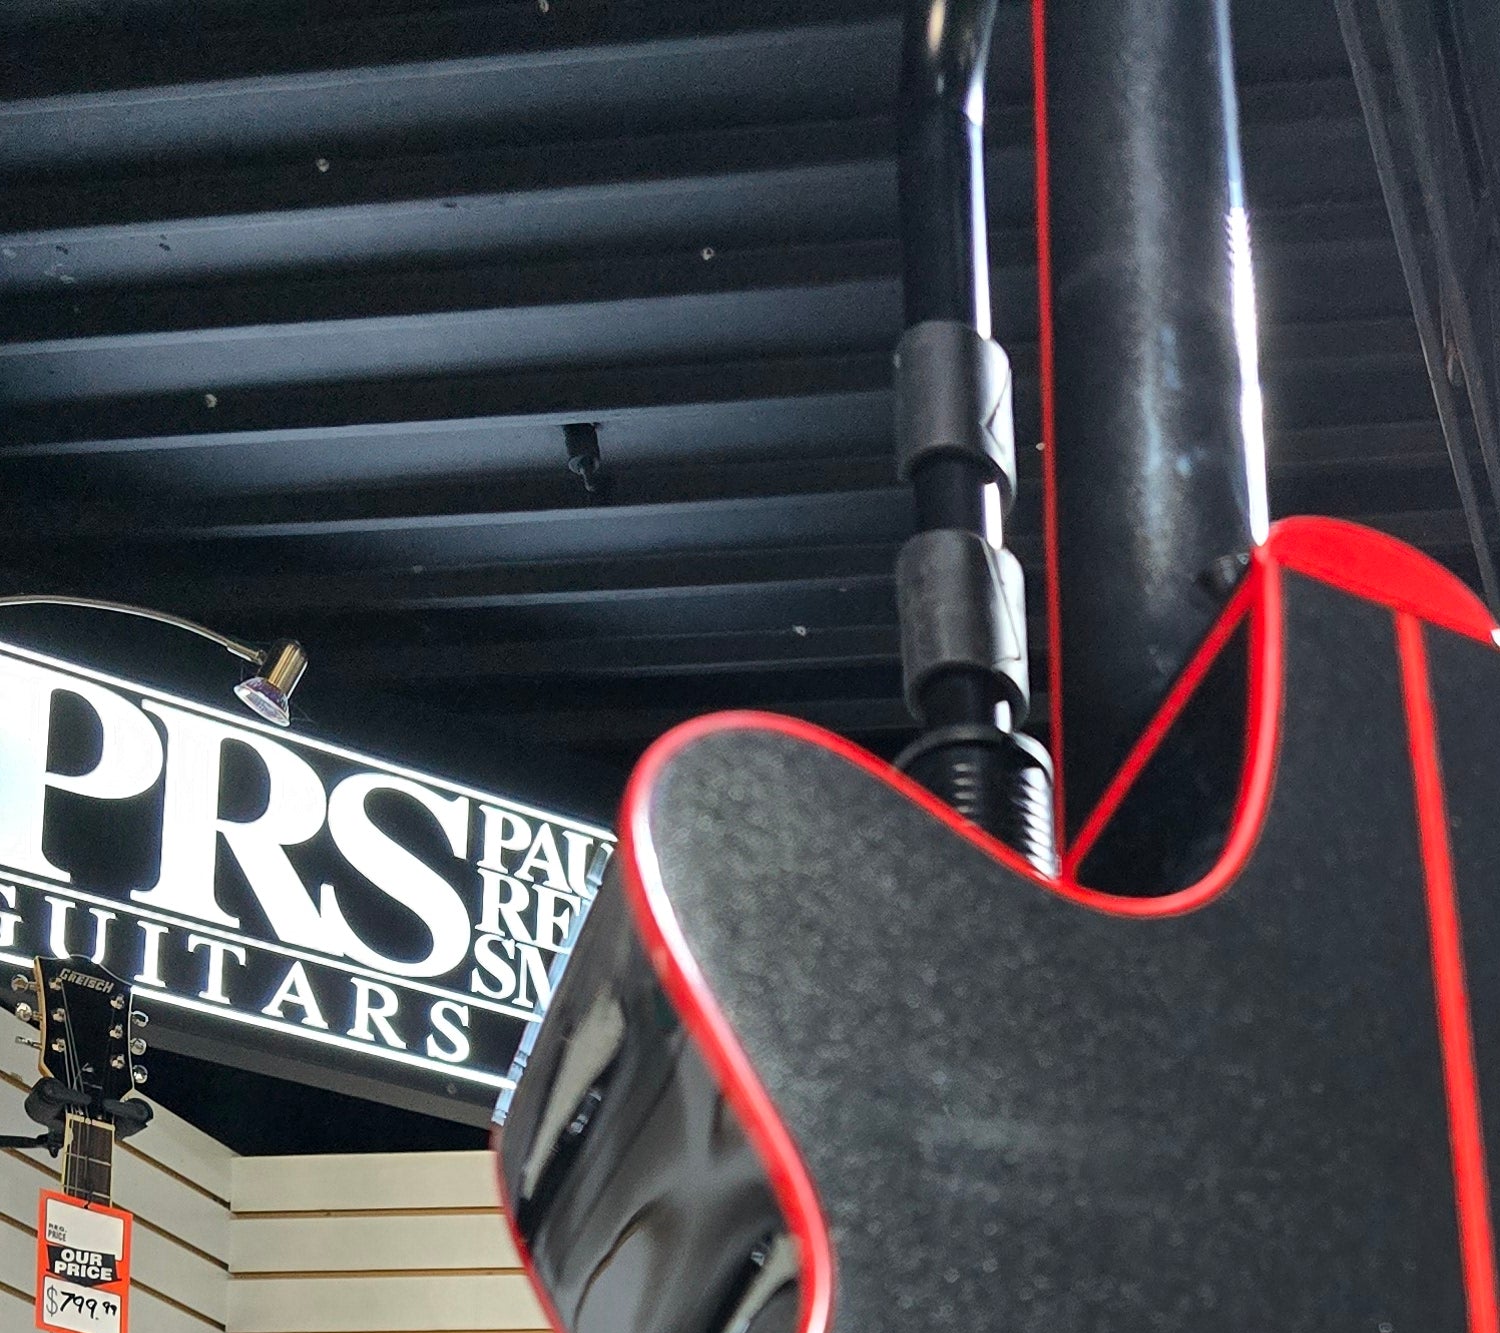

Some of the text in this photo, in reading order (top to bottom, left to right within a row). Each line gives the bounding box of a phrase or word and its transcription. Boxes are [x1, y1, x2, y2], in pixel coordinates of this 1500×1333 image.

[0, 652, 472, 978] PRS
[59, 967, 115, 994] GRETSCH
[48, 1229, 67, 1242] PRICE
[61, 1248, 103, 1266] OUR
[54, 1260, 113, 1281] PRICE
[46, 1284, 117, 1320] $799.99
